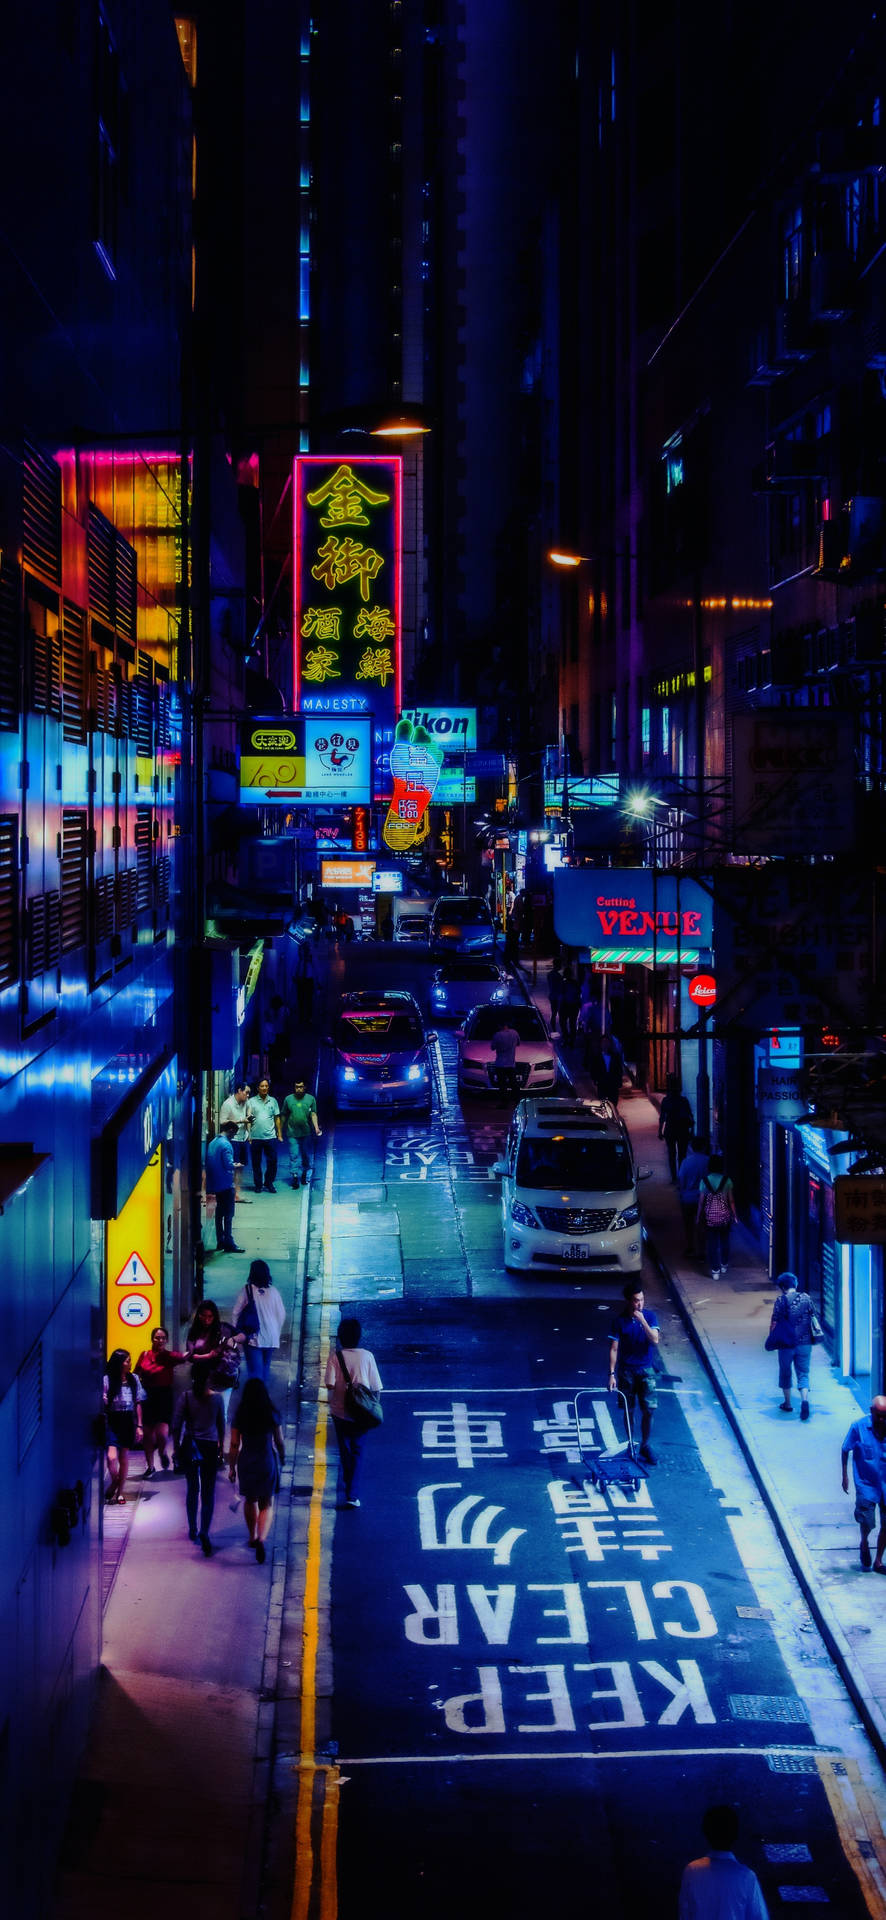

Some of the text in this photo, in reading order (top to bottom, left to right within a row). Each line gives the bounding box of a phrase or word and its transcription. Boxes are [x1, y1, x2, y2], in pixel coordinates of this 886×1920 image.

[306, 464, 390, 602] 金御
[300, 606, 343, 683] 酒家
[353, 606, 396, 688] 海鮮
[303, 698, 368, 711] MAJESTY
[387, 822, 416, 830] FOOT
[595, 896, 637, 909] Cutting
[595, 910, 703, 937] VENUE
[771, 1076, 798, 1086] HAIR
[399, 1165, 496, 1181] EEP
[412, 1400, 640, 1469] 停車
[416, 1479, 673, 1566] 請勿
[402, 1580, 720, 1646] CLEAR
[442, 1659, 718, 1734] KEEP
